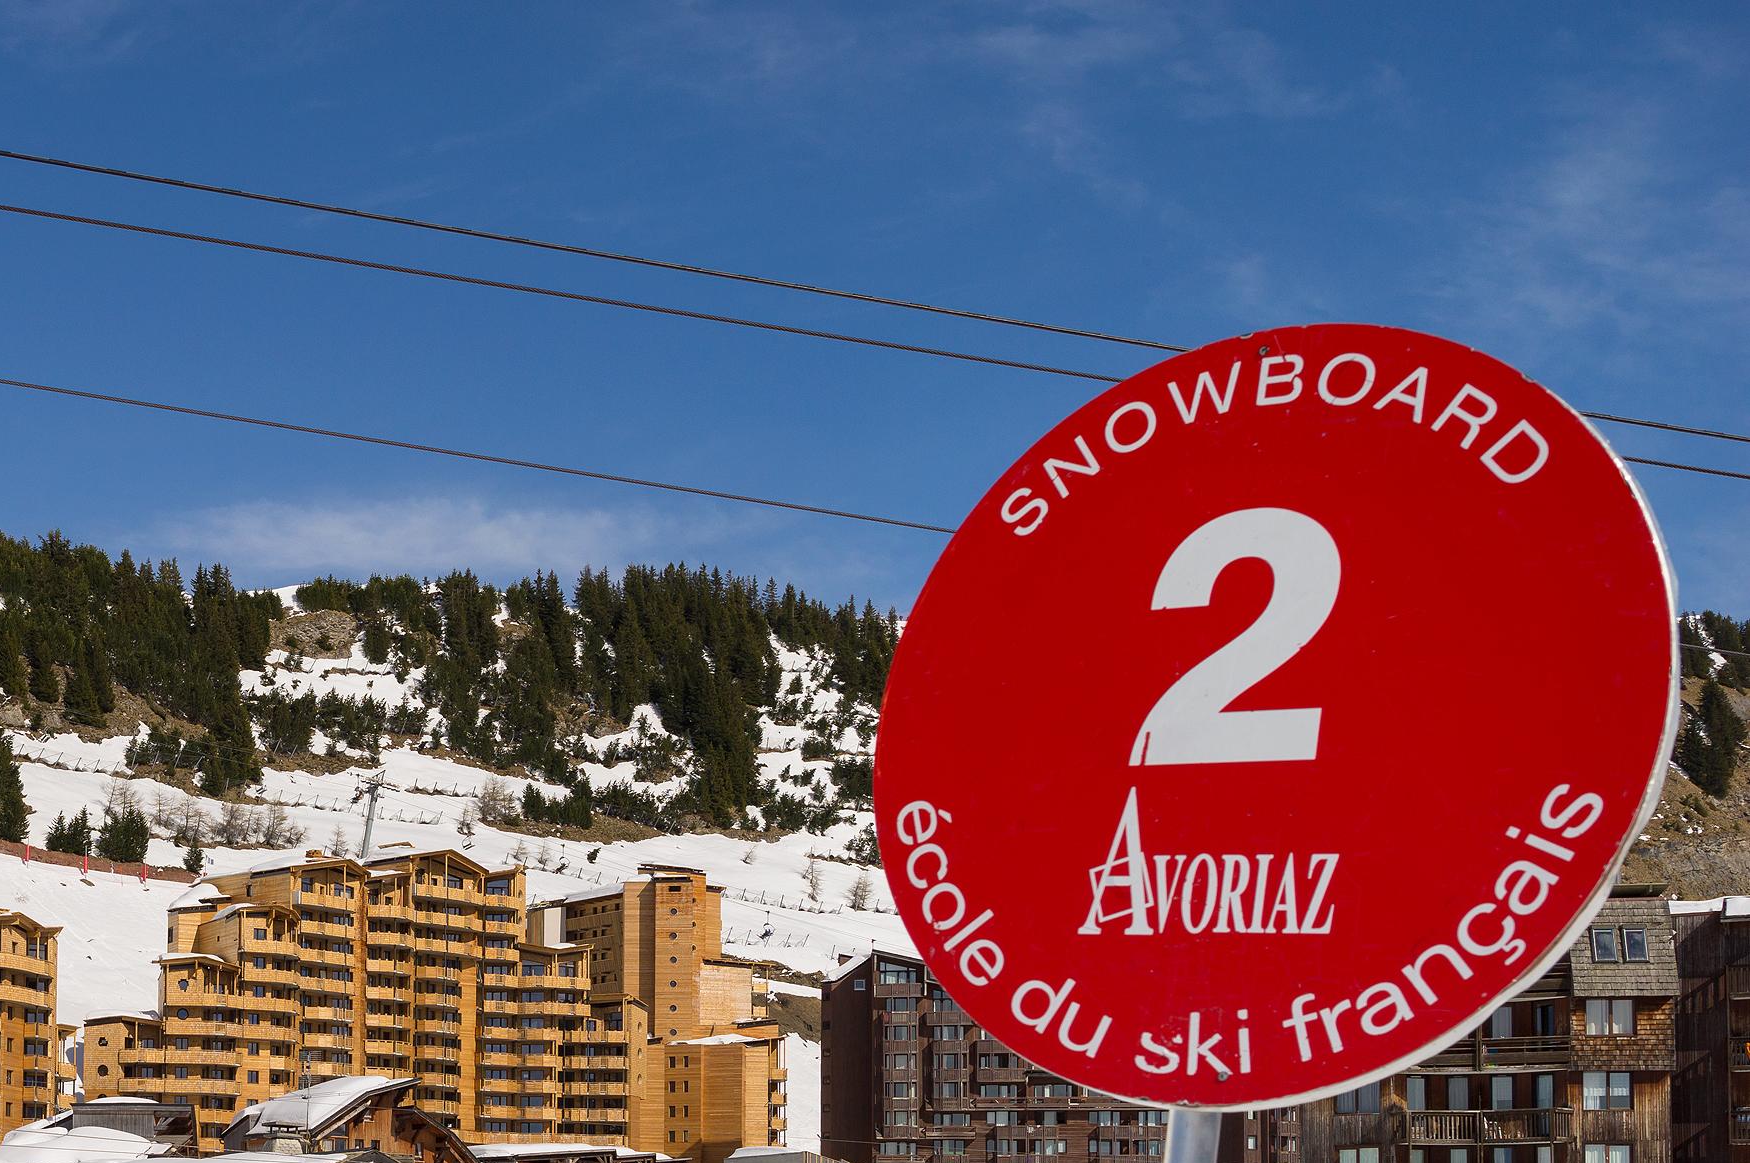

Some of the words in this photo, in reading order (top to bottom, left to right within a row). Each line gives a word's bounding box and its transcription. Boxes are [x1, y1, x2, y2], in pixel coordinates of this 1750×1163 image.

[1000, 353, 1549, 536] SNOWBOARD
[1128, 507, 1342, 767] 2
[897, 800, 1005, 988] école
[1011, 978, 1114, 1059] du
[1134, 1009, 1251, 1081] ski
[1282, 783, 1604, 1063] français
